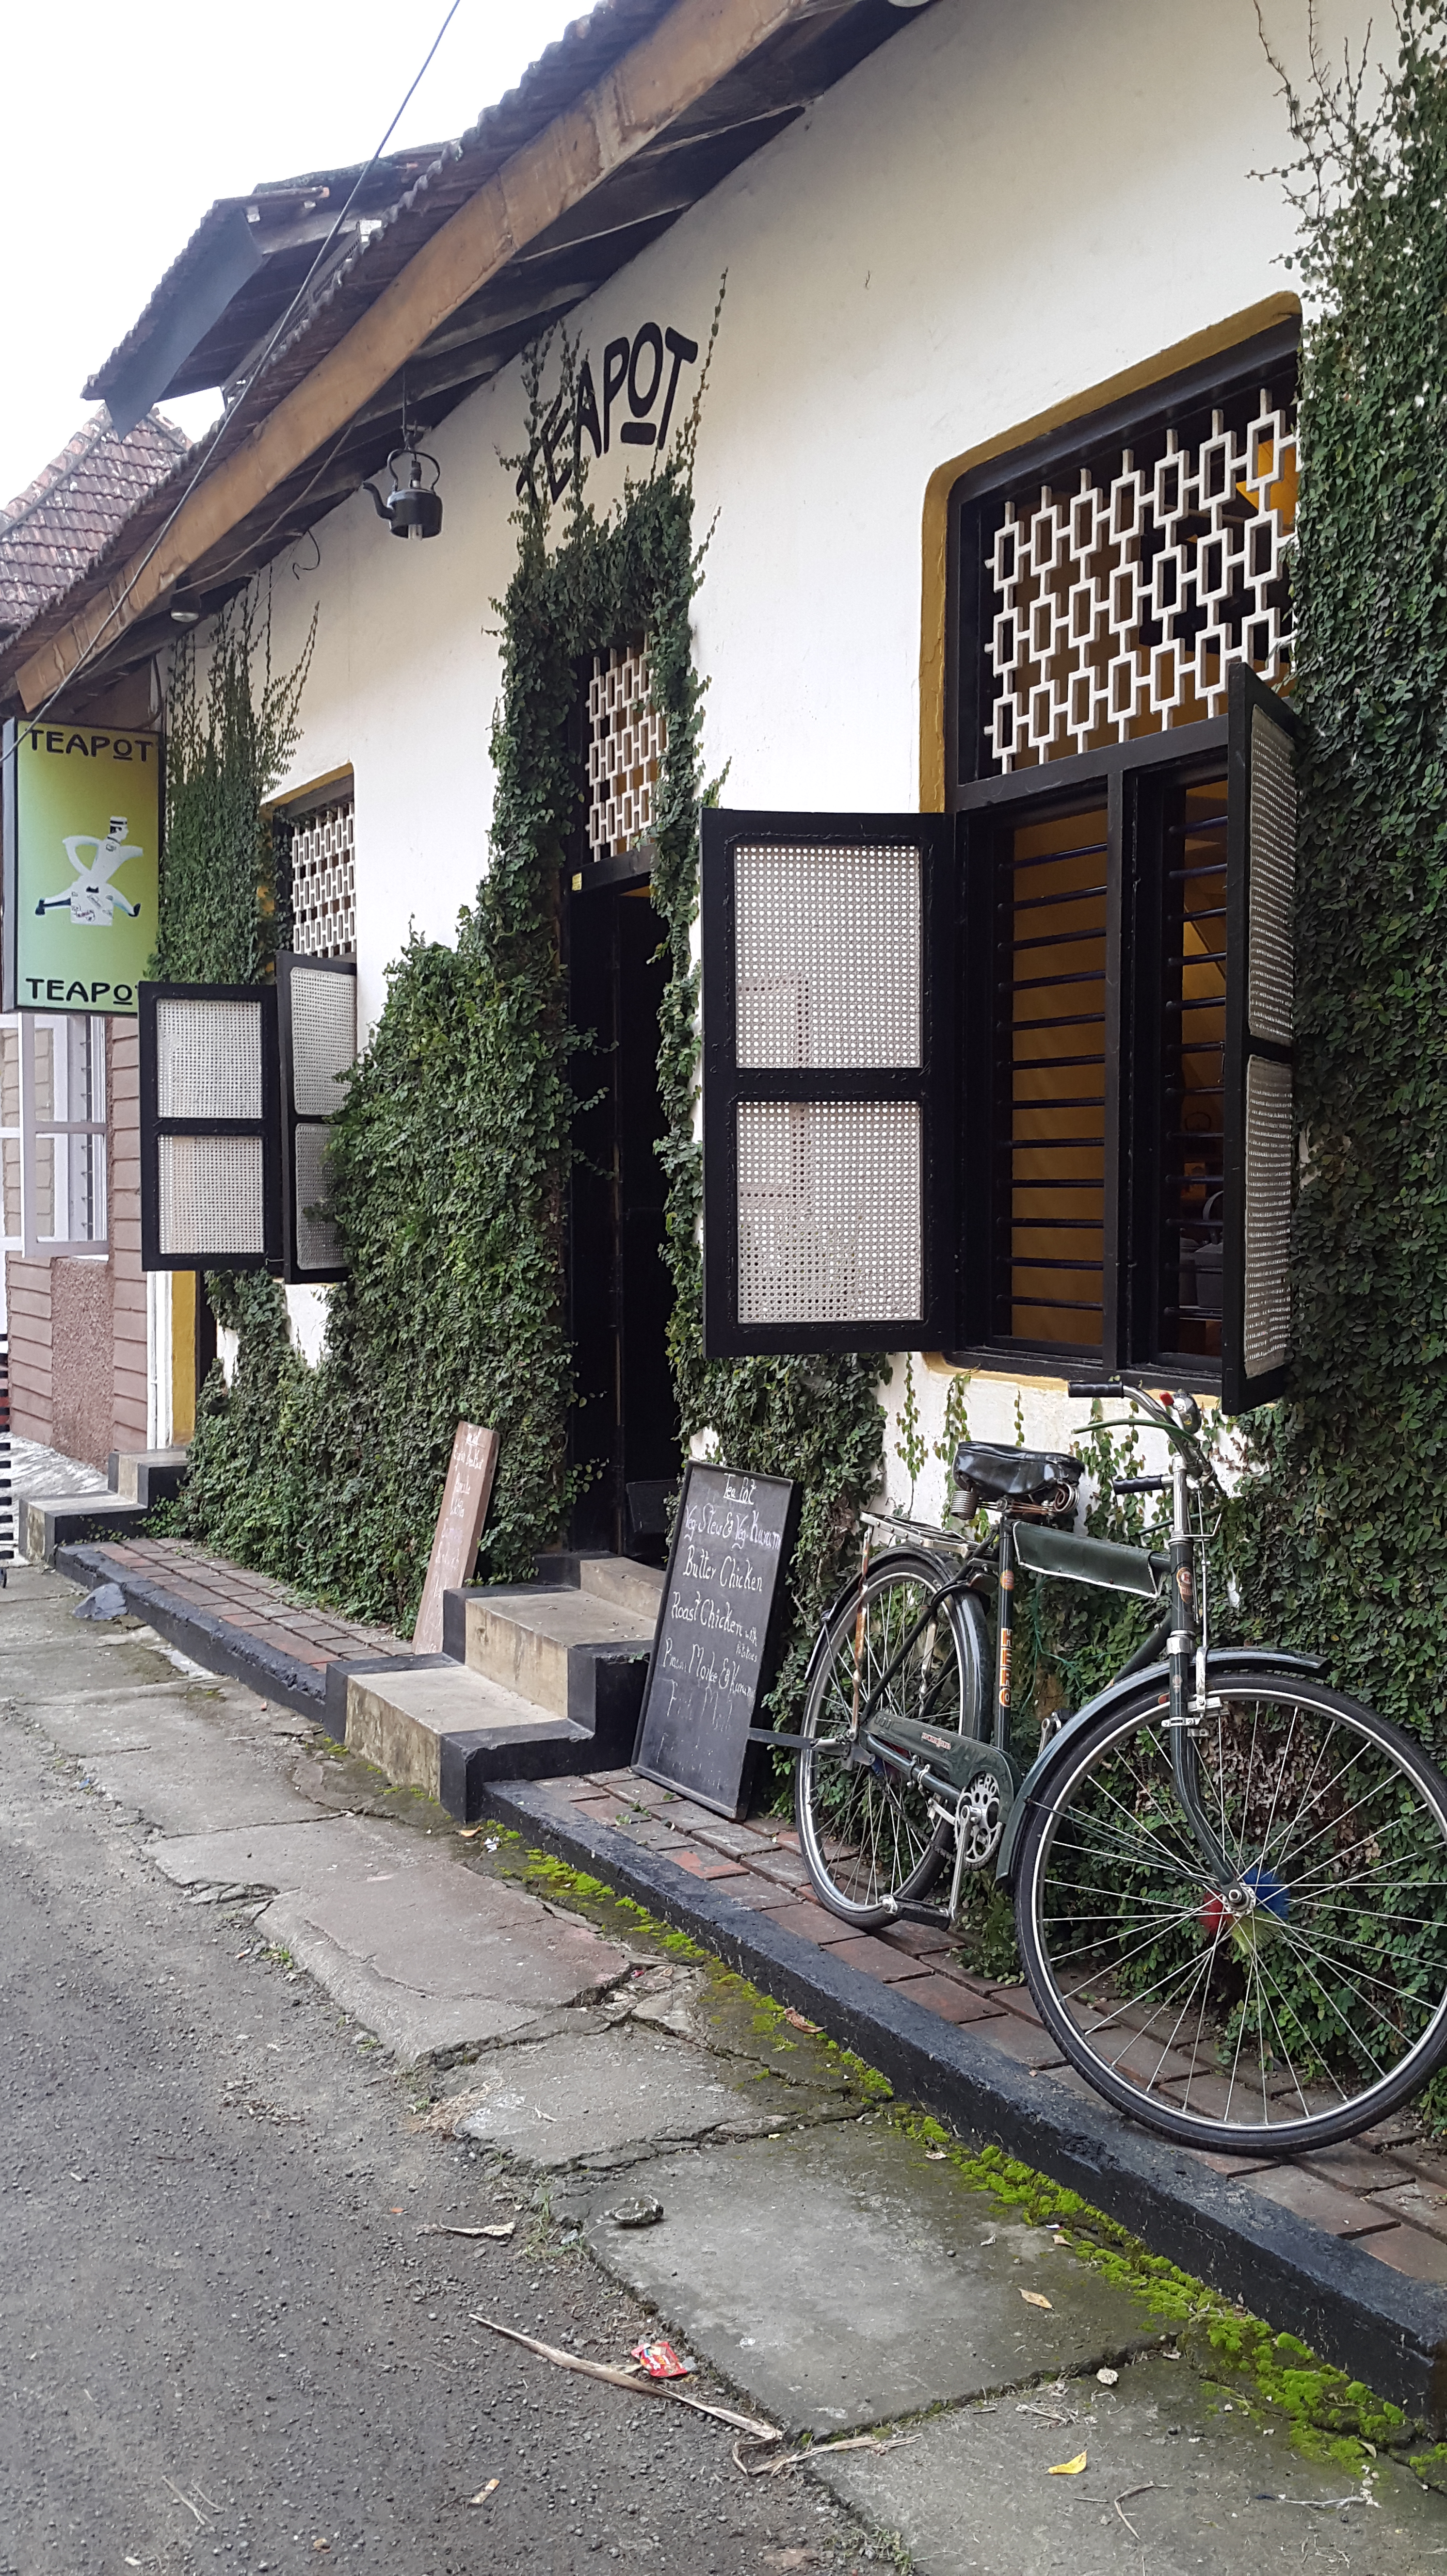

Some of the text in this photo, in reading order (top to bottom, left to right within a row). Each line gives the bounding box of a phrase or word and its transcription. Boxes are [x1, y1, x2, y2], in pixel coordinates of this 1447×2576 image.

[26, 729, 153, 762] TEAPOT
[26, 978, 138, 1005] TEAPO
[724, 1473, 757, 1504] Tea Pot
[698, 1503, 723, 1536] Stew
[722, 1512, 734, 1538] &
[682, 1545, 763, 1592] Butter Chicken
[671, 1591, 702, 1622] Roast
[700, 1599, 743, 1637] Chicken
[718, 1658, 731, 1690] &
[999, 1627, 1013, 1707] HERO
